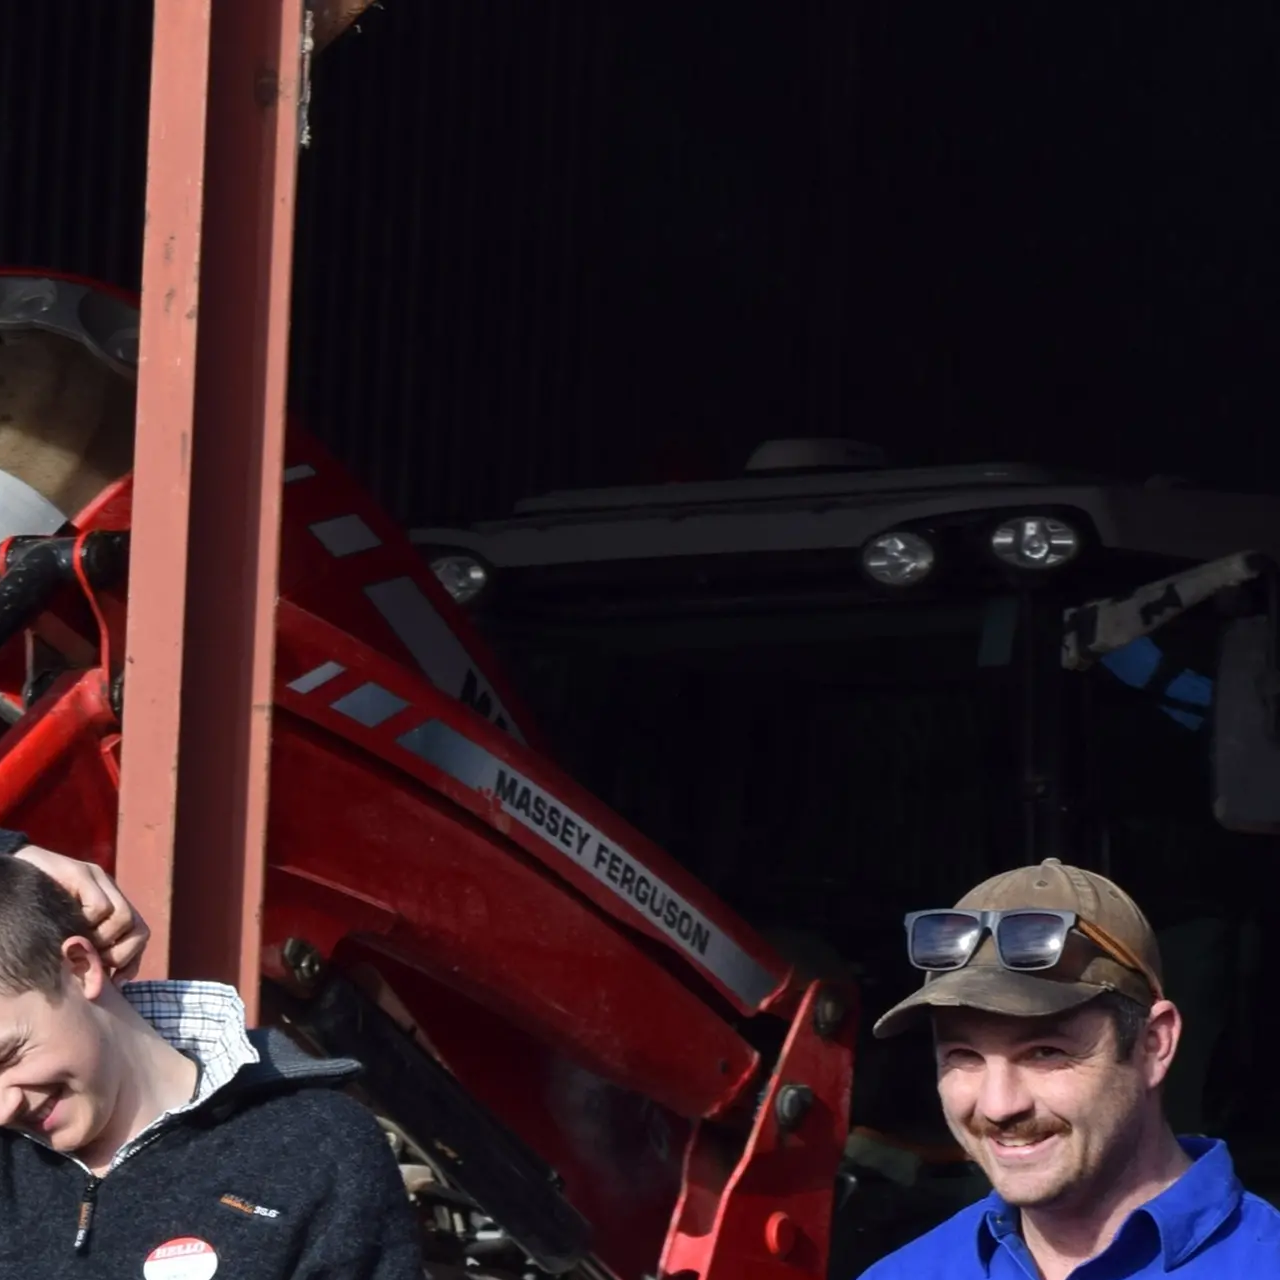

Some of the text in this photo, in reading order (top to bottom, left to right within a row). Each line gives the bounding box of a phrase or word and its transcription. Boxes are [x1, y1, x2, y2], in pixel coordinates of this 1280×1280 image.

[493, 768, 711, 957] MASSEY FERGUSON
[155, 1242, 205, 1258] HELLO
